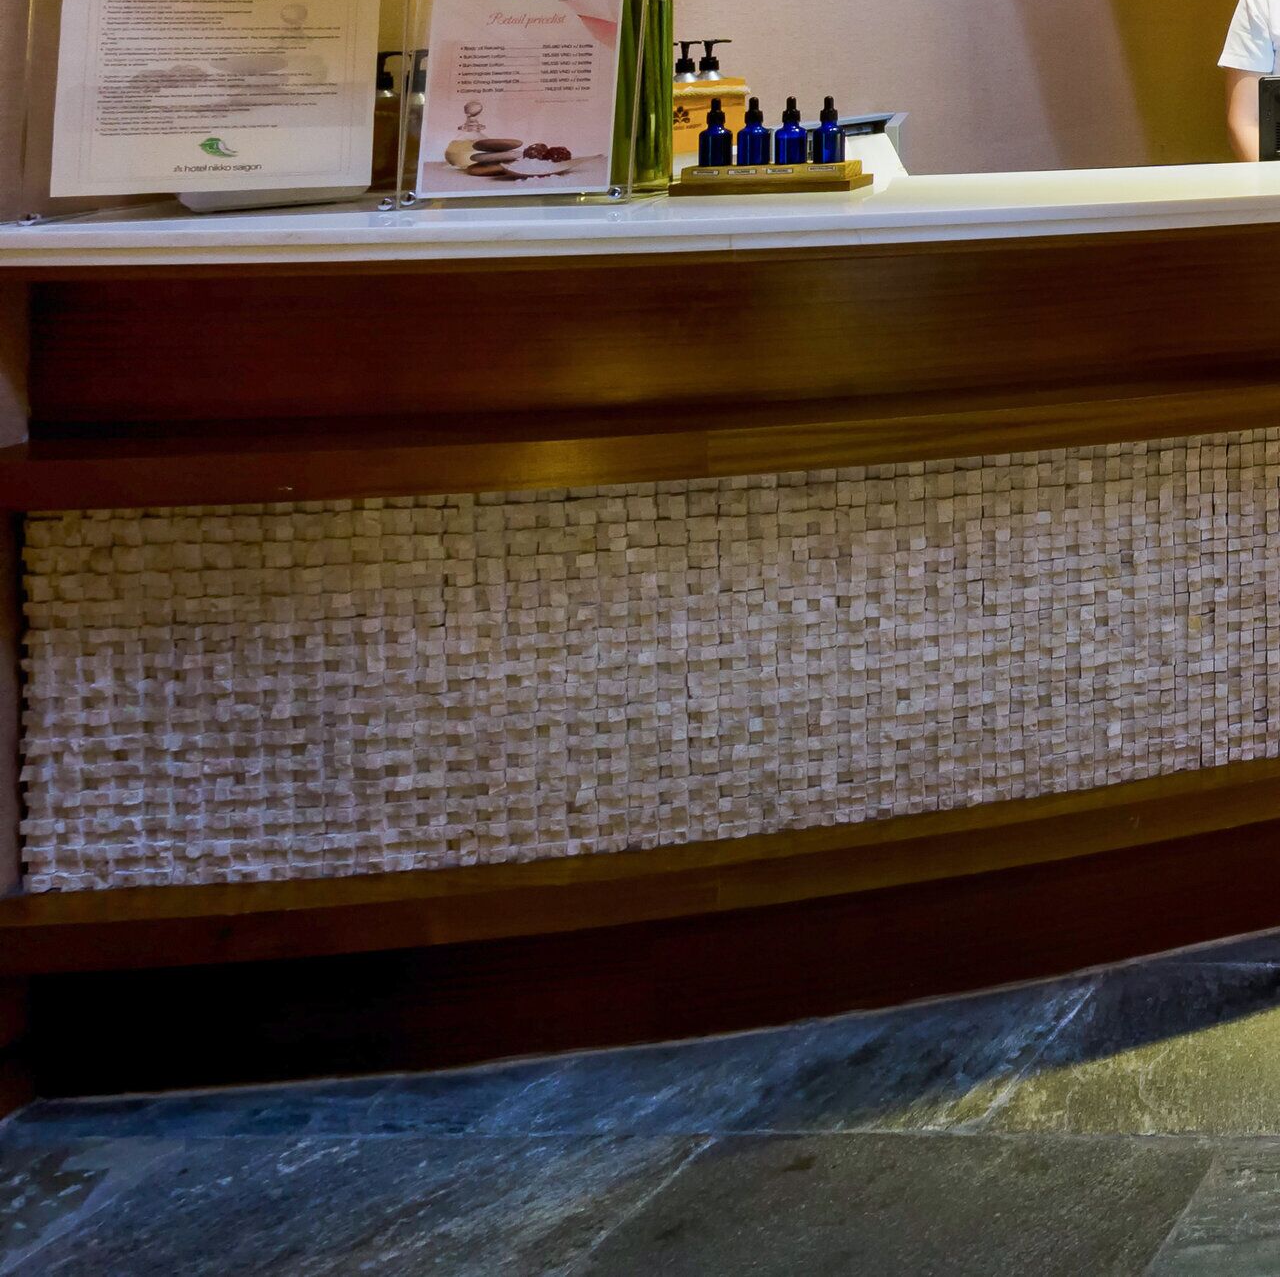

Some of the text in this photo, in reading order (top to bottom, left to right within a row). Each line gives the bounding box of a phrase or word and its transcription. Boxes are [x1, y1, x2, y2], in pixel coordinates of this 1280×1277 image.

[486, 12, 526, 25] Retail
[184, 164, 208, 172] hotel
[233, 163, 263, 172] saigon
